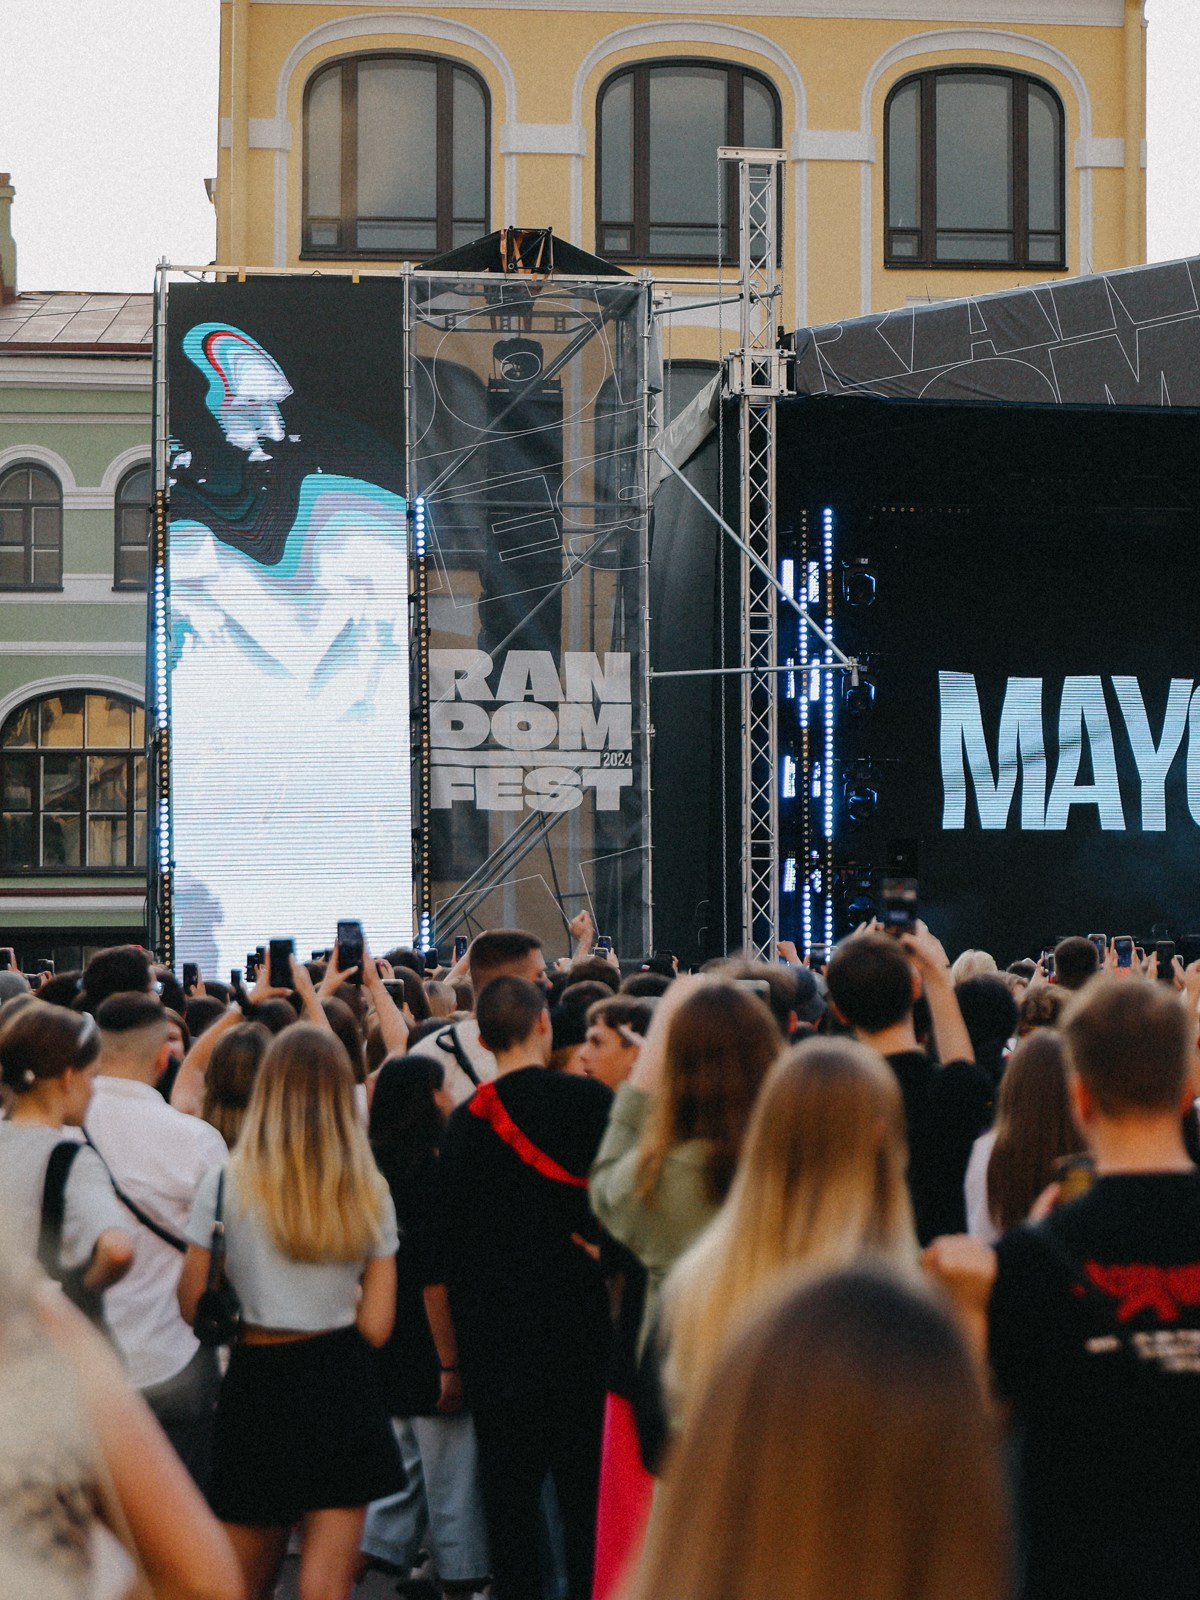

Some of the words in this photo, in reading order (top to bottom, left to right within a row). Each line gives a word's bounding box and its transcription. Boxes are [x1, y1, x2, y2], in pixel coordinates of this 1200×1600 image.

[428, 649, 631, 702] RAN
[429, 701, 633, 750] DOM
[603, 752, 632, 767] 2024
[429, 766, 633, 812] FEST
